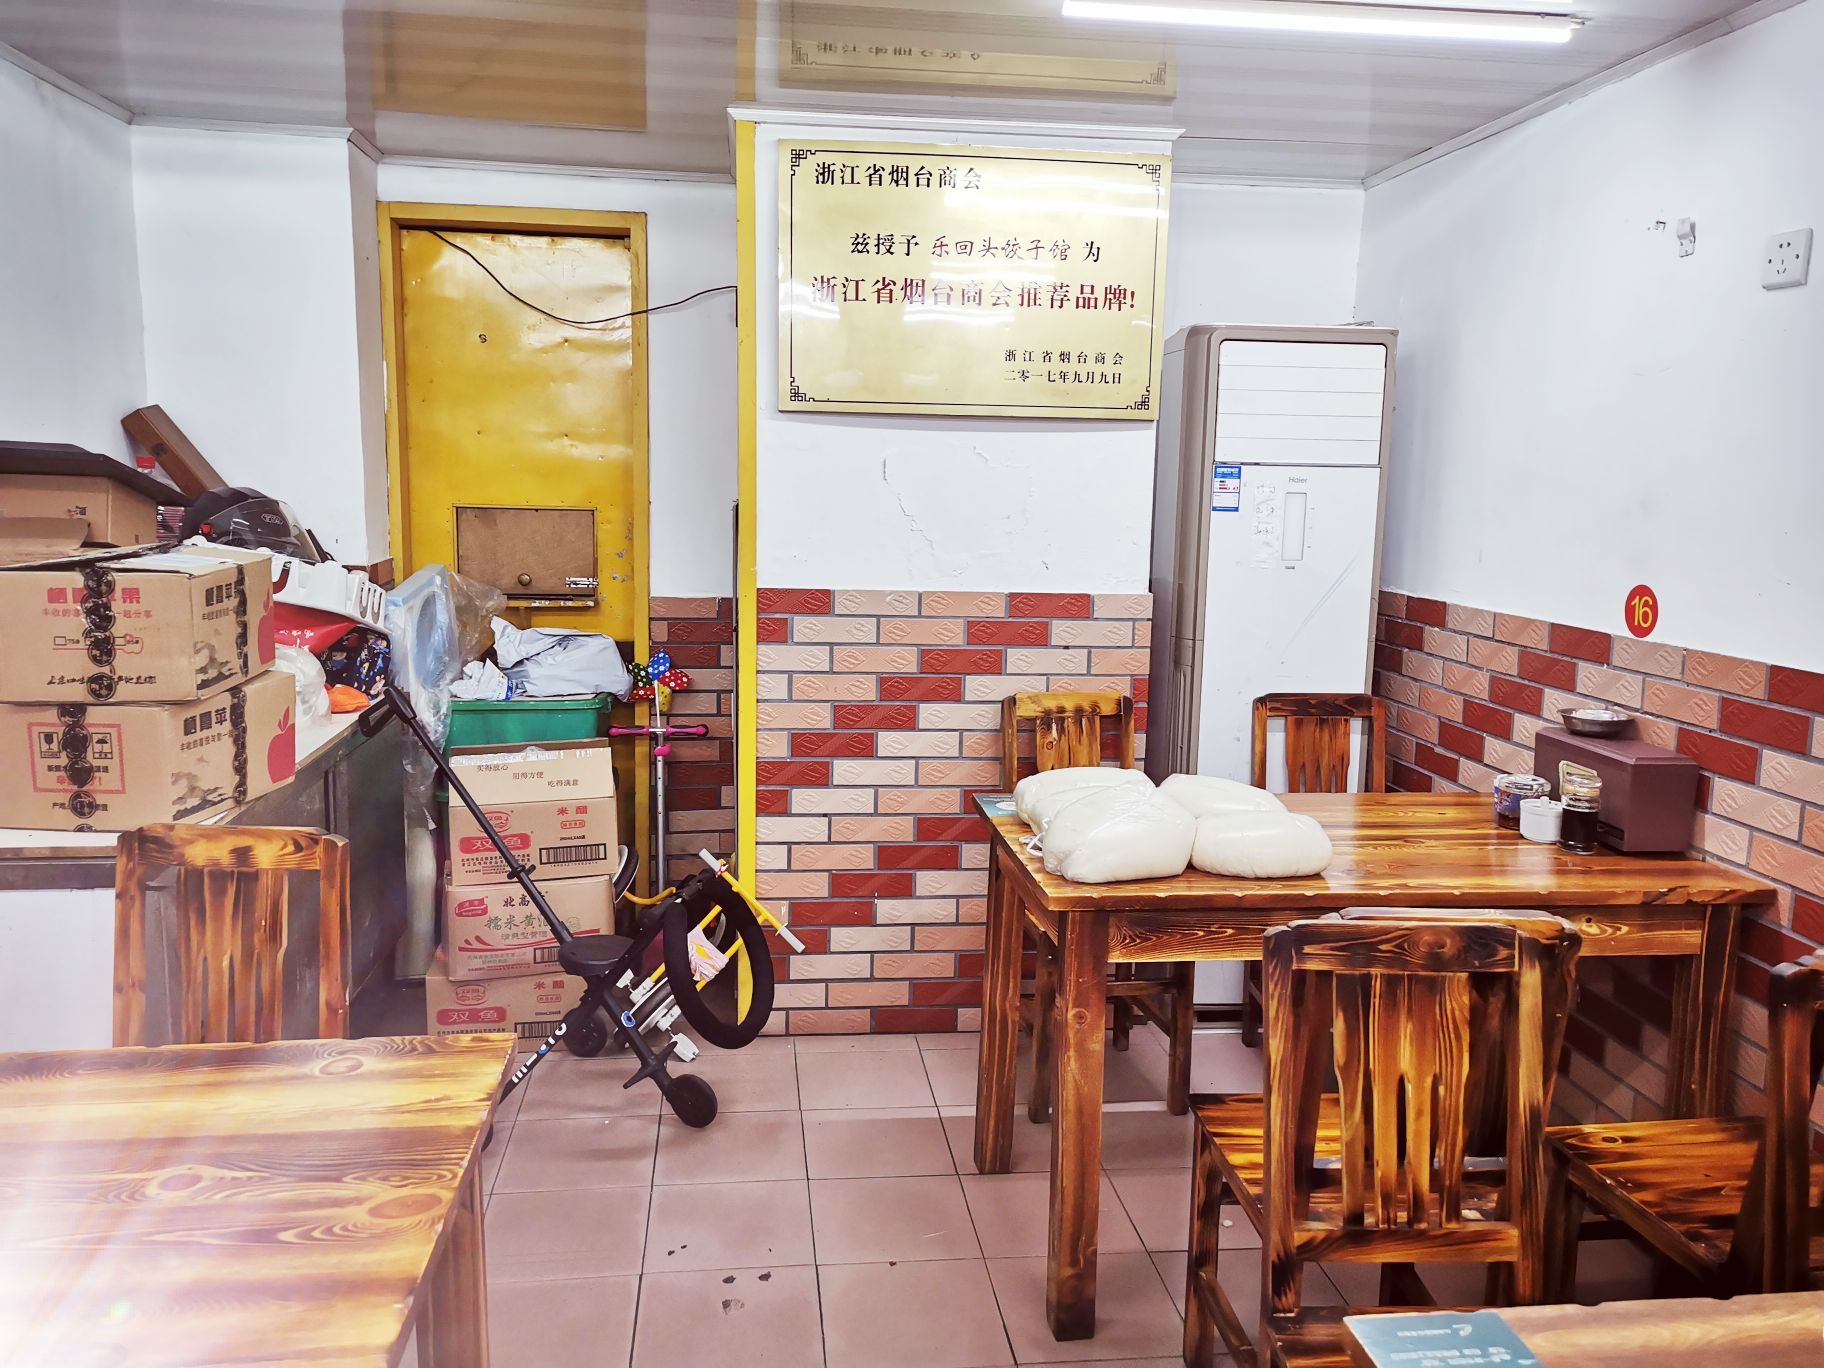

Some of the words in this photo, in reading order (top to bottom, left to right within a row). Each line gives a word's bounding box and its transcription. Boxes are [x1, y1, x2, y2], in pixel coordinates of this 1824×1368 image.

[815, 161, 982, 190] 浙江省烟台商会
[850, 232, 919, 257] 兹授予
[931, 234, 1071, 262] 乐回头饺子馆
[1082, 240, 1101, 263] 为
[811, 275, 1136, 312] 浙江省烟台商会推荐品牌!
[1004, 348, 1124, 366] 浙江省烟台商会
[1003, 368, 1122, 385] 二零一七年九月九日
[1288, 476, 1308, 485] Haier
[1630, 595, 1653, 628] 16
[448, 1009, 499, 1022] 双鱼
